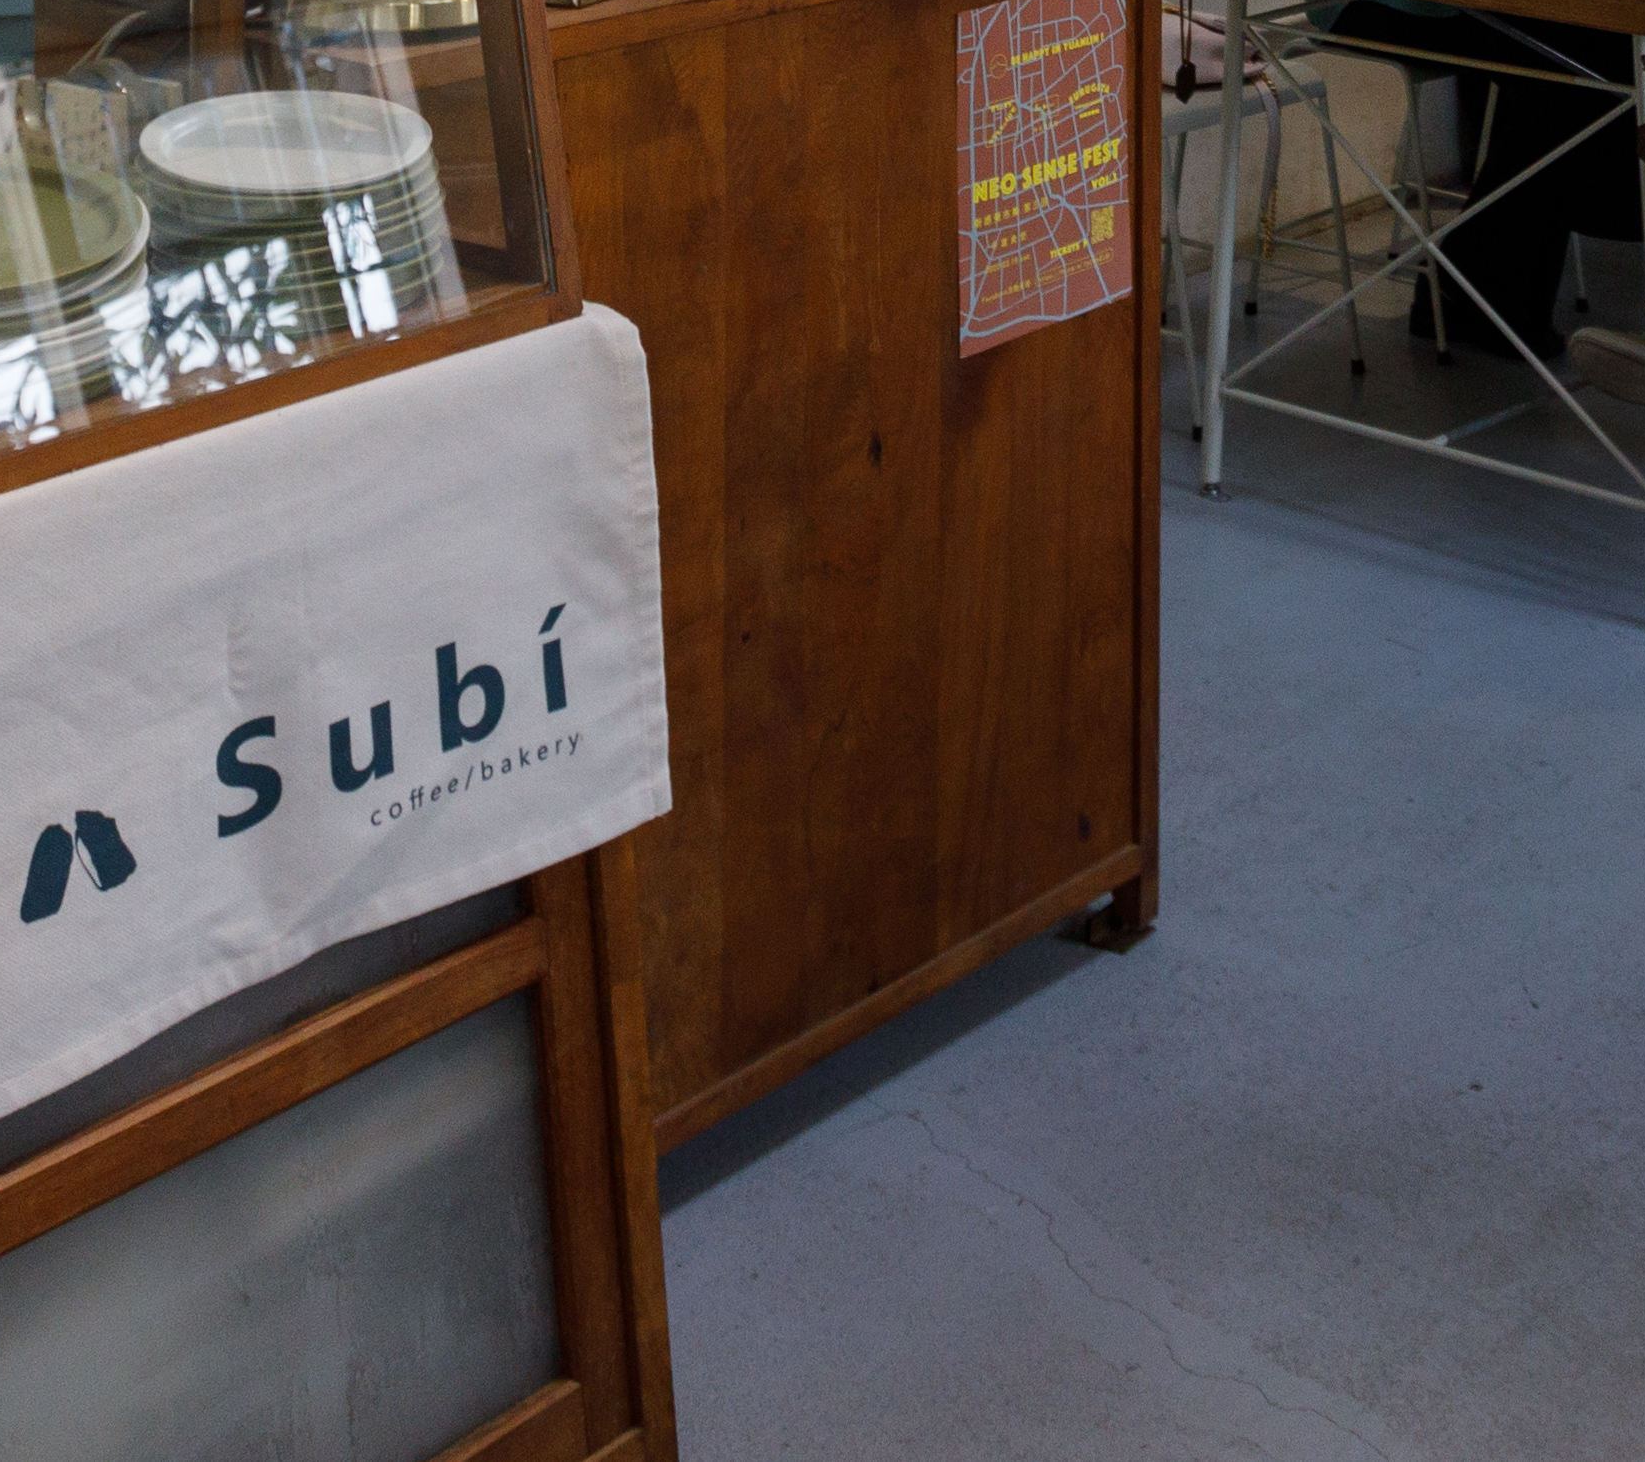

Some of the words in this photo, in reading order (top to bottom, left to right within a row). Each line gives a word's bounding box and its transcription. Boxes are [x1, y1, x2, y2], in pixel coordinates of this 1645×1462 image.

[1022, 46, 1050, 62] HAPPY
[973, 173, 1016, 204] NEO
[1021, 152, 1078, 190] SENSE
[1082, 138, 1121, 170] FEST
[216, 602, 569, 839] Subí
[369, 732, 580, 827] coffee/bakery
